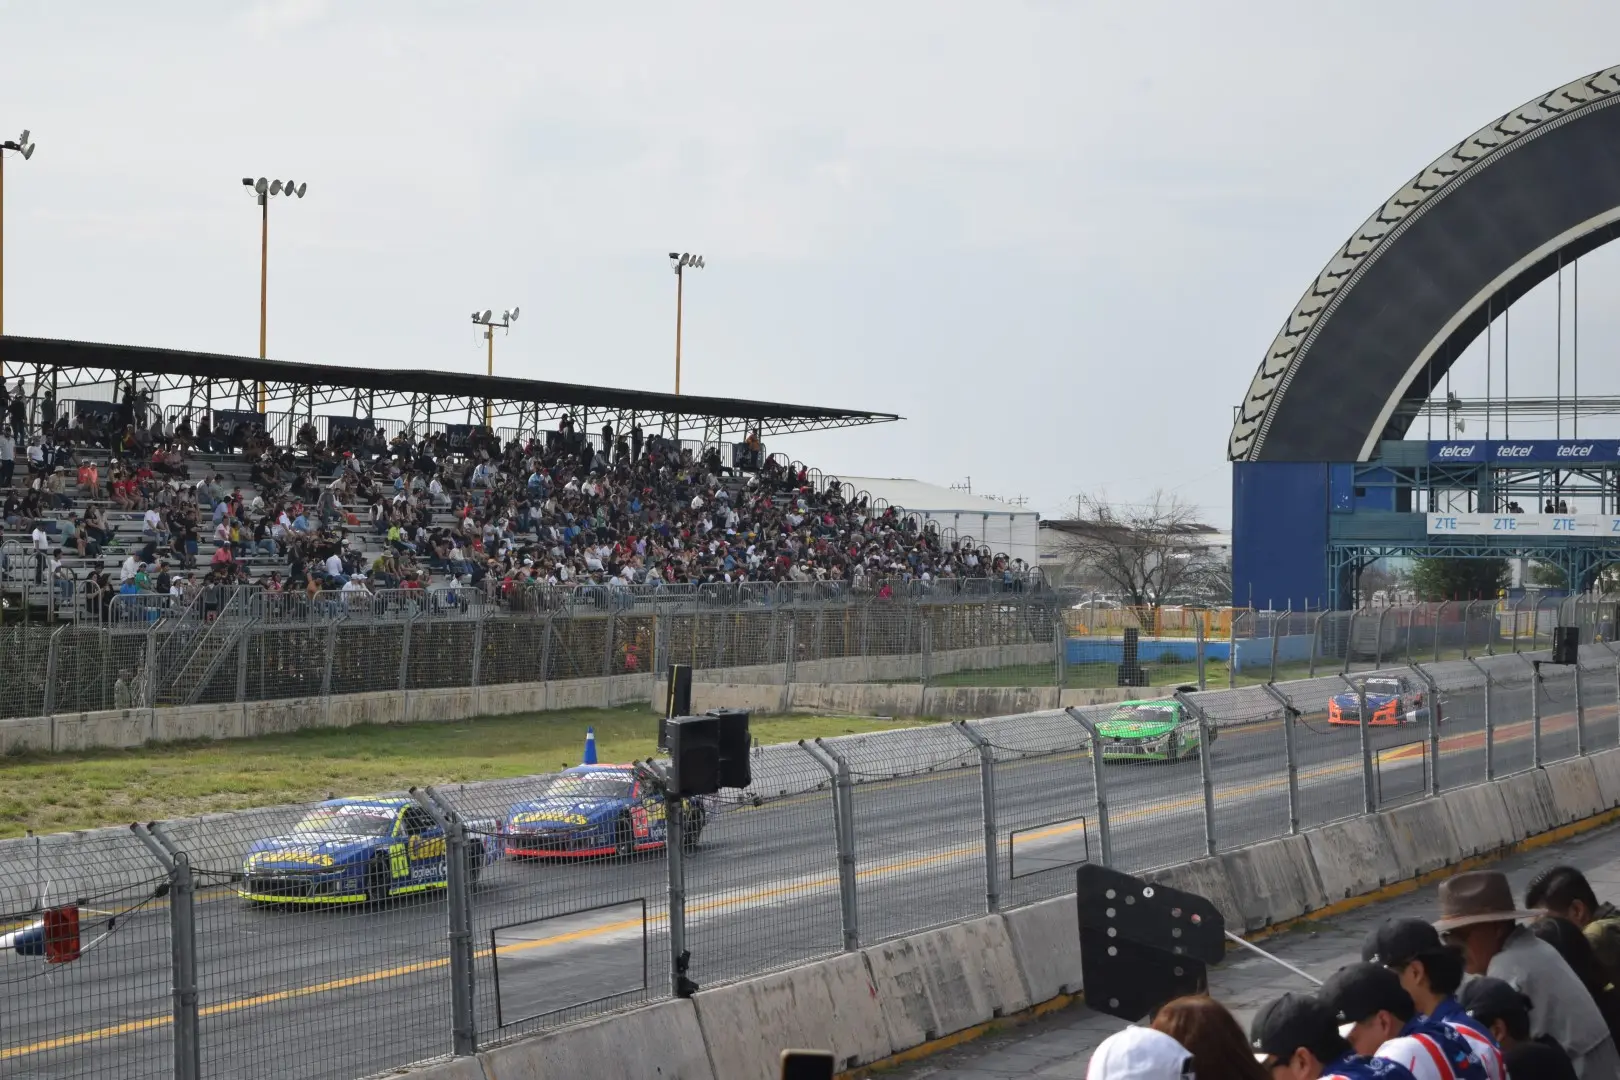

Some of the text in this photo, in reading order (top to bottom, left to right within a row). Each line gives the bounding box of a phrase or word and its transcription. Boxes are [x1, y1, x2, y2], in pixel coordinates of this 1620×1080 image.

[1439, 445, 1475, 457] telcel
[1496, 445, 1533, 457] telcel
[1556, 445, 1594, 457] telcel
[1435, 518, 1457, 530] ZTE
[1493, 518, 1516, 530] ZTE
[1553, 519, 1575, 531] ZTE
